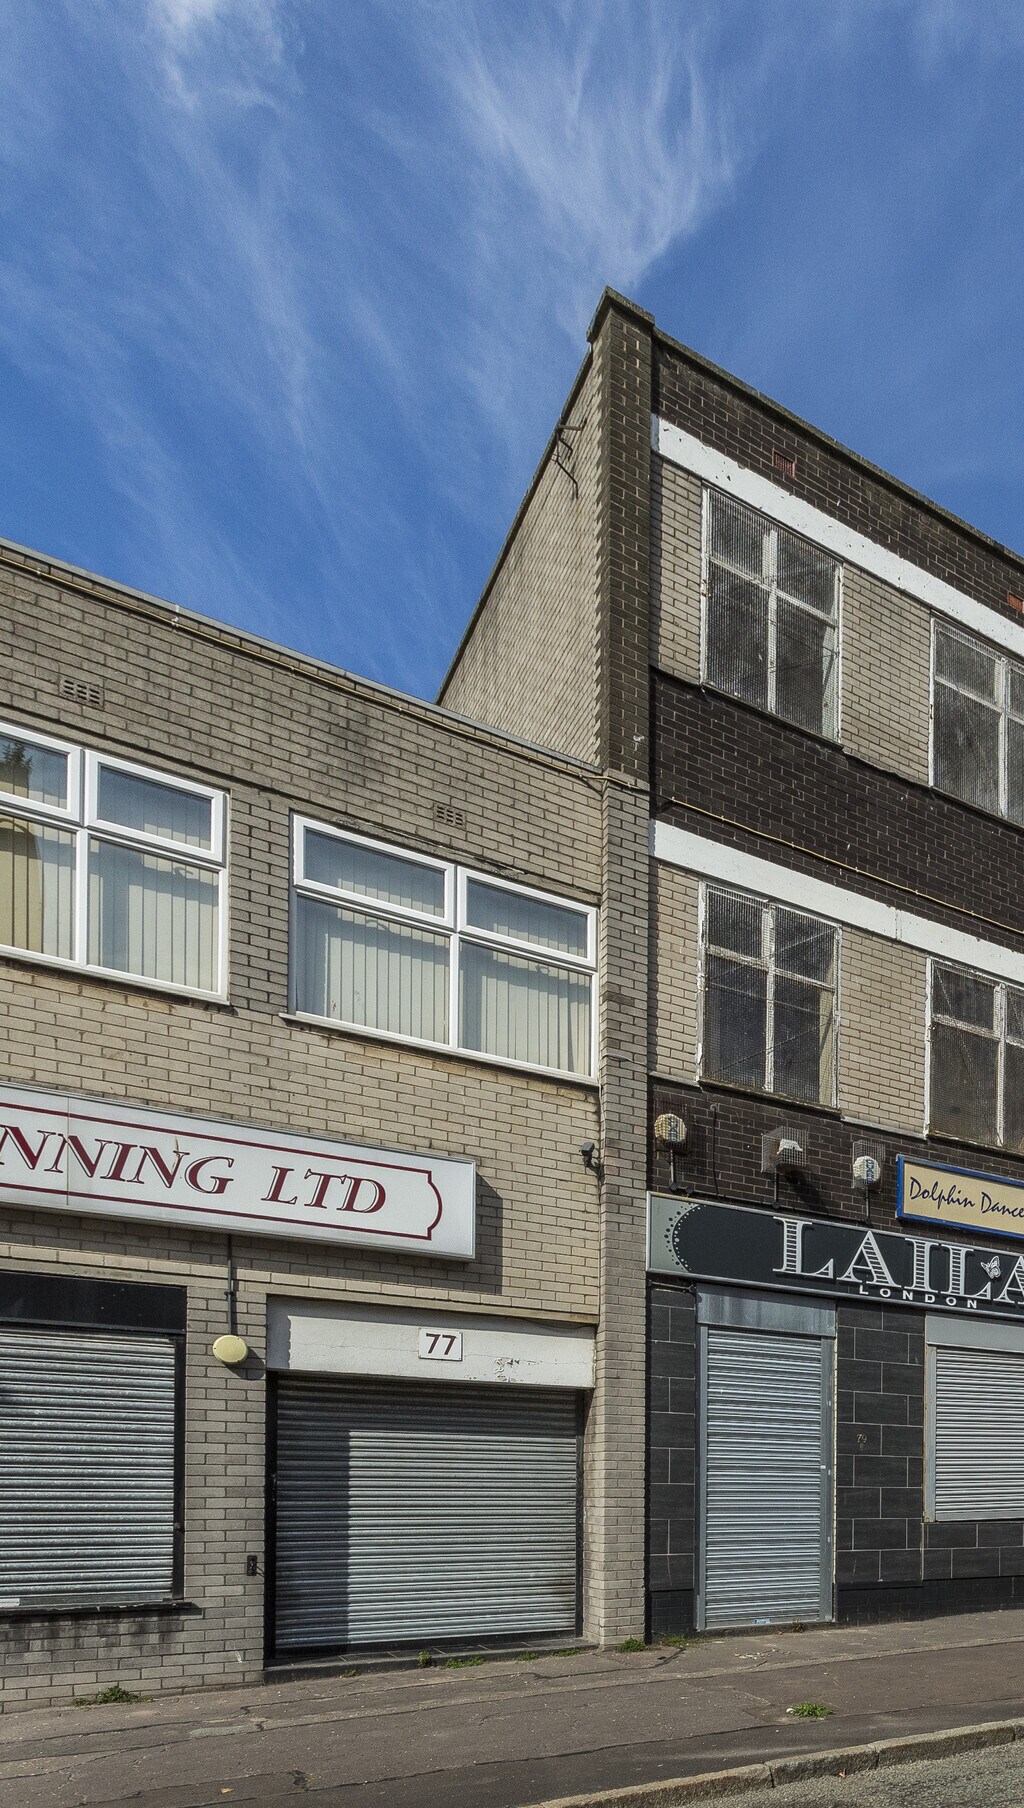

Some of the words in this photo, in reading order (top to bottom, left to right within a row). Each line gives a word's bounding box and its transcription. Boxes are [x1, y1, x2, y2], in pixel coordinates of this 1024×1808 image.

[261, 1166, 386, 1214] LTD
[910, 1176, 975, 1210] Dolphin
[859, 1285, 978, 1309] LONDON
[425, 1333, 457, 1356] 77
